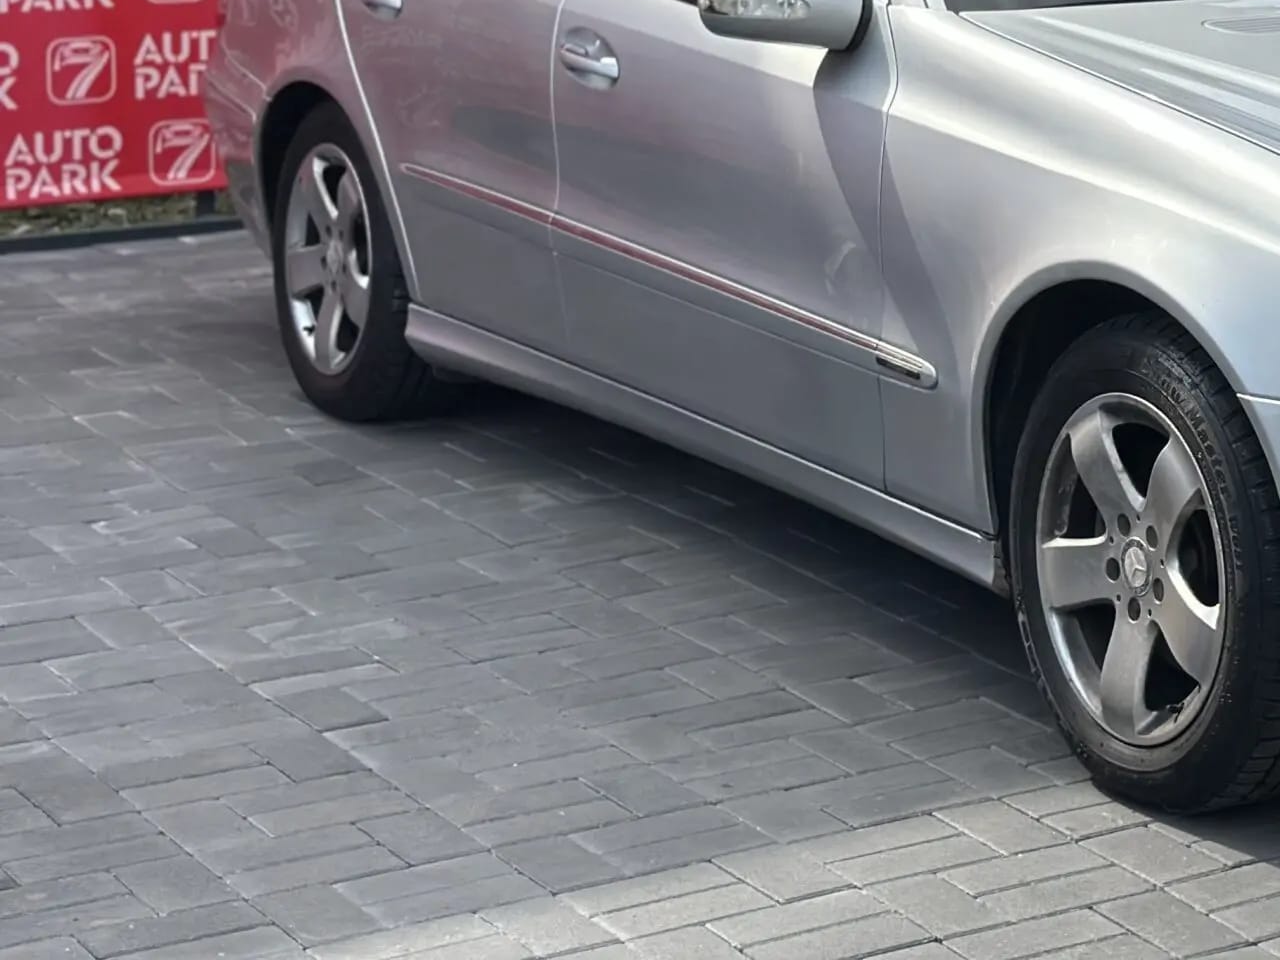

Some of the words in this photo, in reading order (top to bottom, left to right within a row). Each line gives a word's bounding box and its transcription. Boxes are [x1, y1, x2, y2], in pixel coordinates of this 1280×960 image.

[134, 30, 217, 67] AUT
[135, 64, 208, 100] PA
[4, 125, 123, 168] AUTO
[5, 158, 123, 202] PARK
